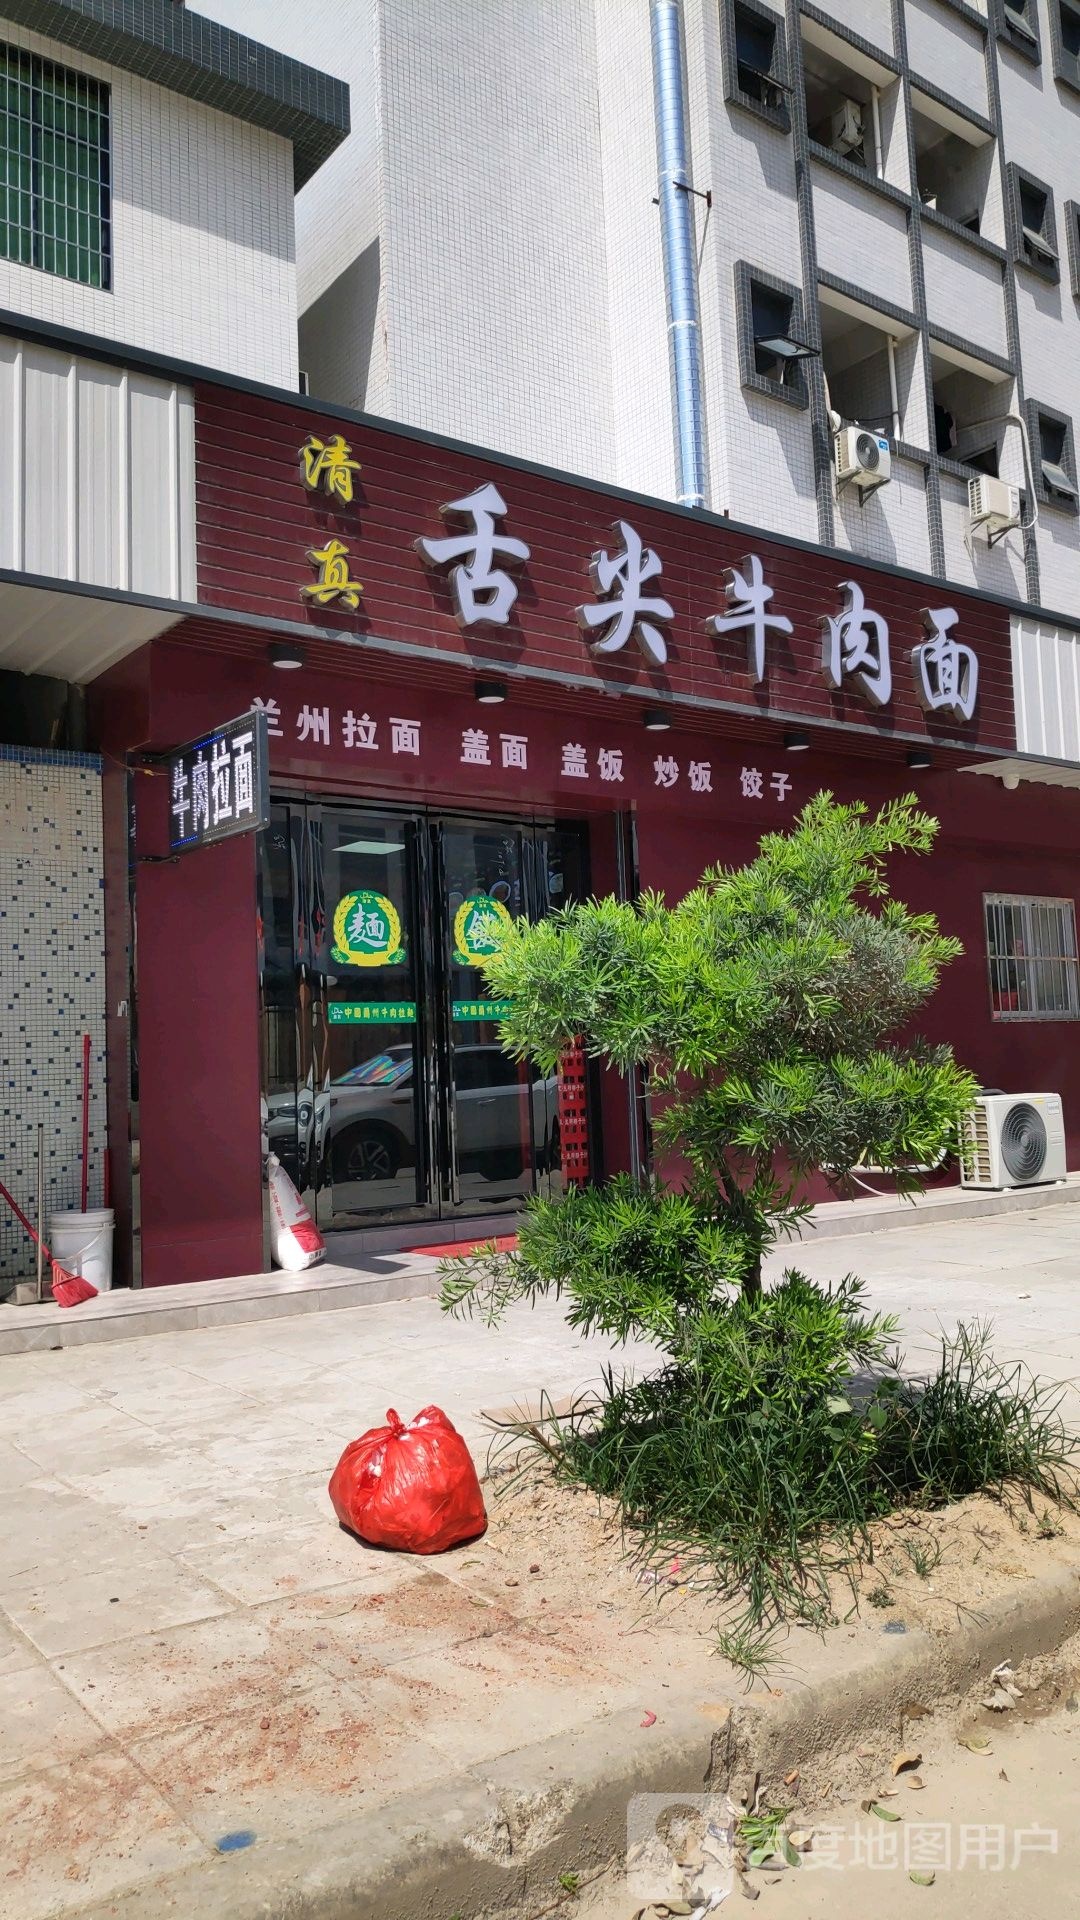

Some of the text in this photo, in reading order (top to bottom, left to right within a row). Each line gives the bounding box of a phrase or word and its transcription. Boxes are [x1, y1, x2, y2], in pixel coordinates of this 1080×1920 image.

[301, 434, 363, 610] 清真
[418, 482, 980, 723] 舌尖牛肉面
[172, 731, 254, 838] 牛肉拉面
[250, 697, 793, 802] 兰州拉面 盖面 盖饭 炒饭 饺子
